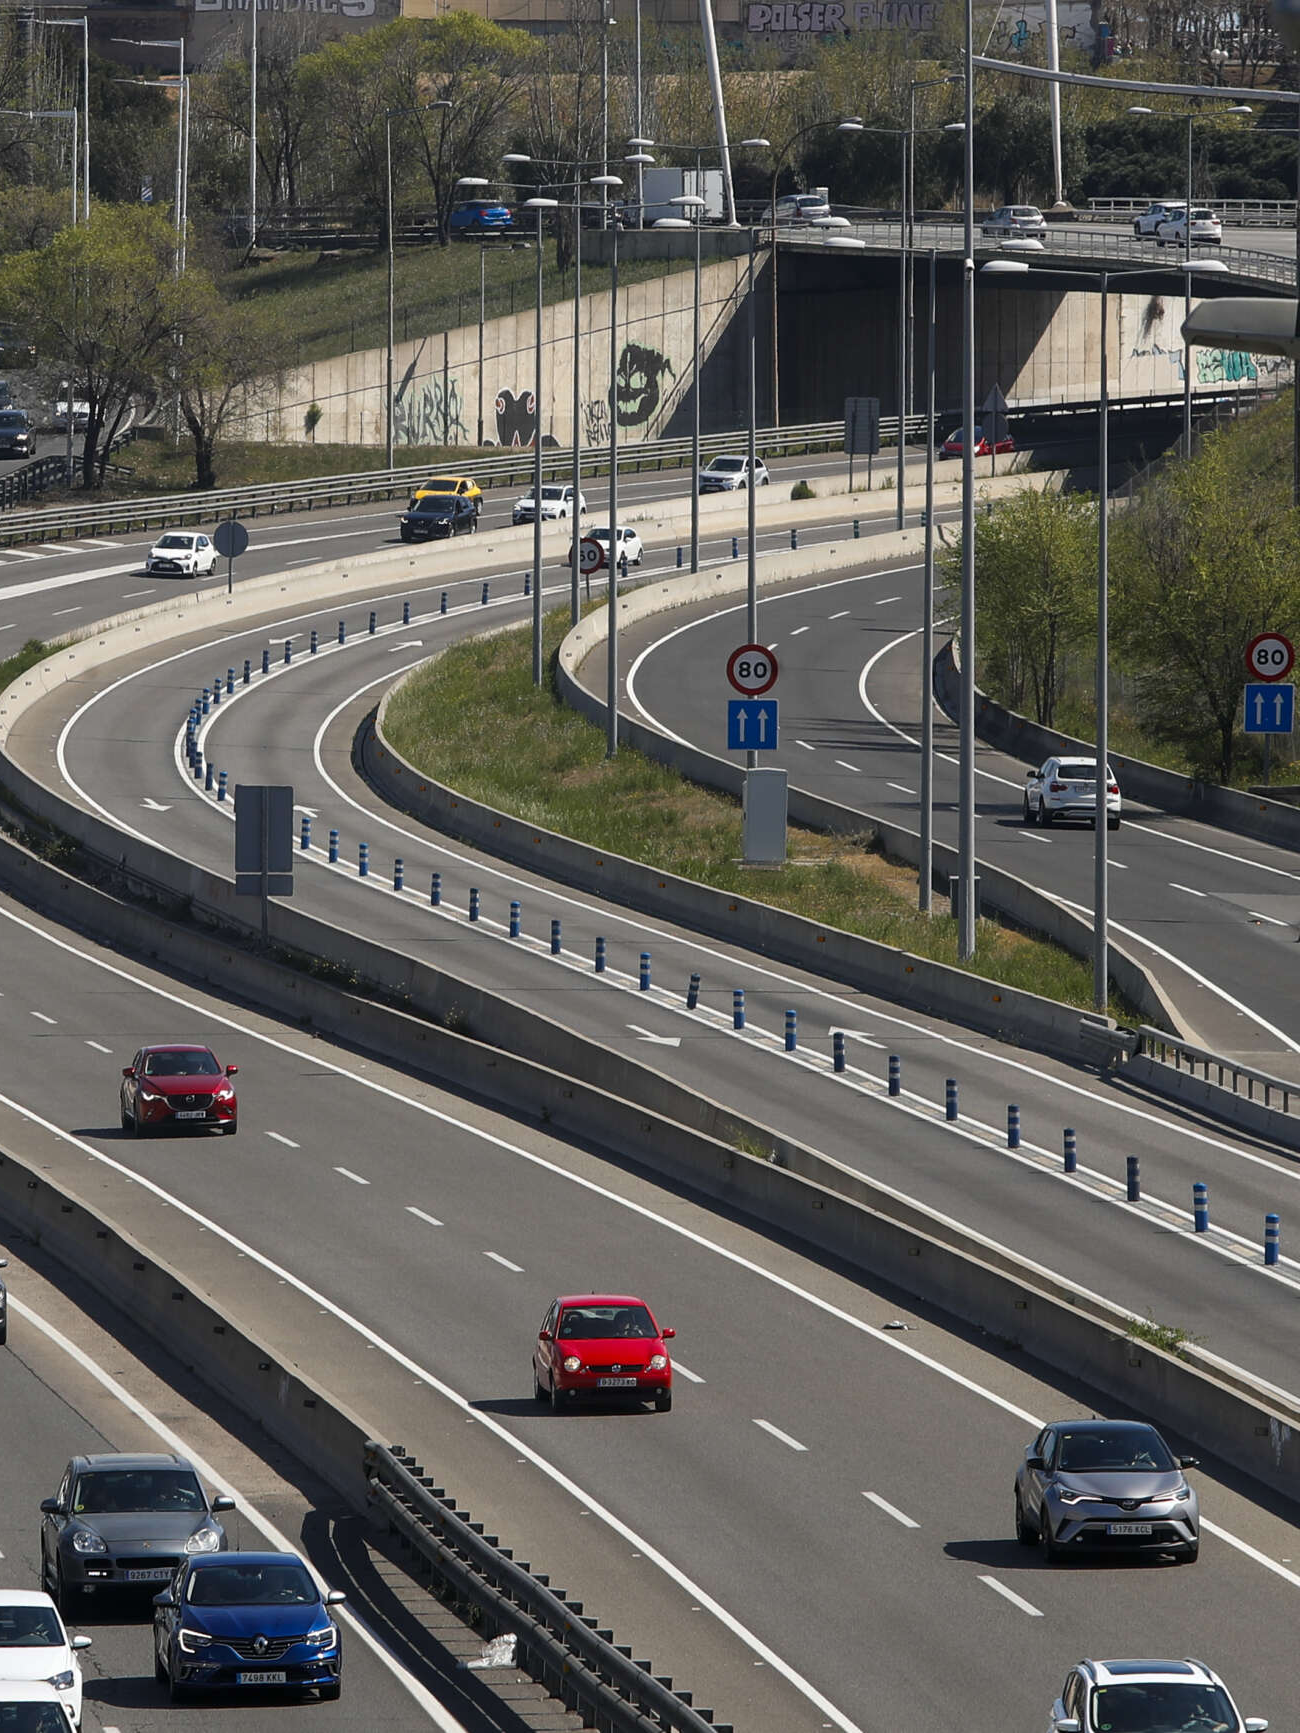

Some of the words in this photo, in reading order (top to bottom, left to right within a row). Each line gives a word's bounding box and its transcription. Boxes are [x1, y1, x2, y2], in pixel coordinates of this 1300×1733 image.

[1257, 649, 1285, 665] 80
[738, 661, 767, 678] 80
[242, 1673, 264, 1682] 7498
[266, 1672, 283, 1682] KKL
